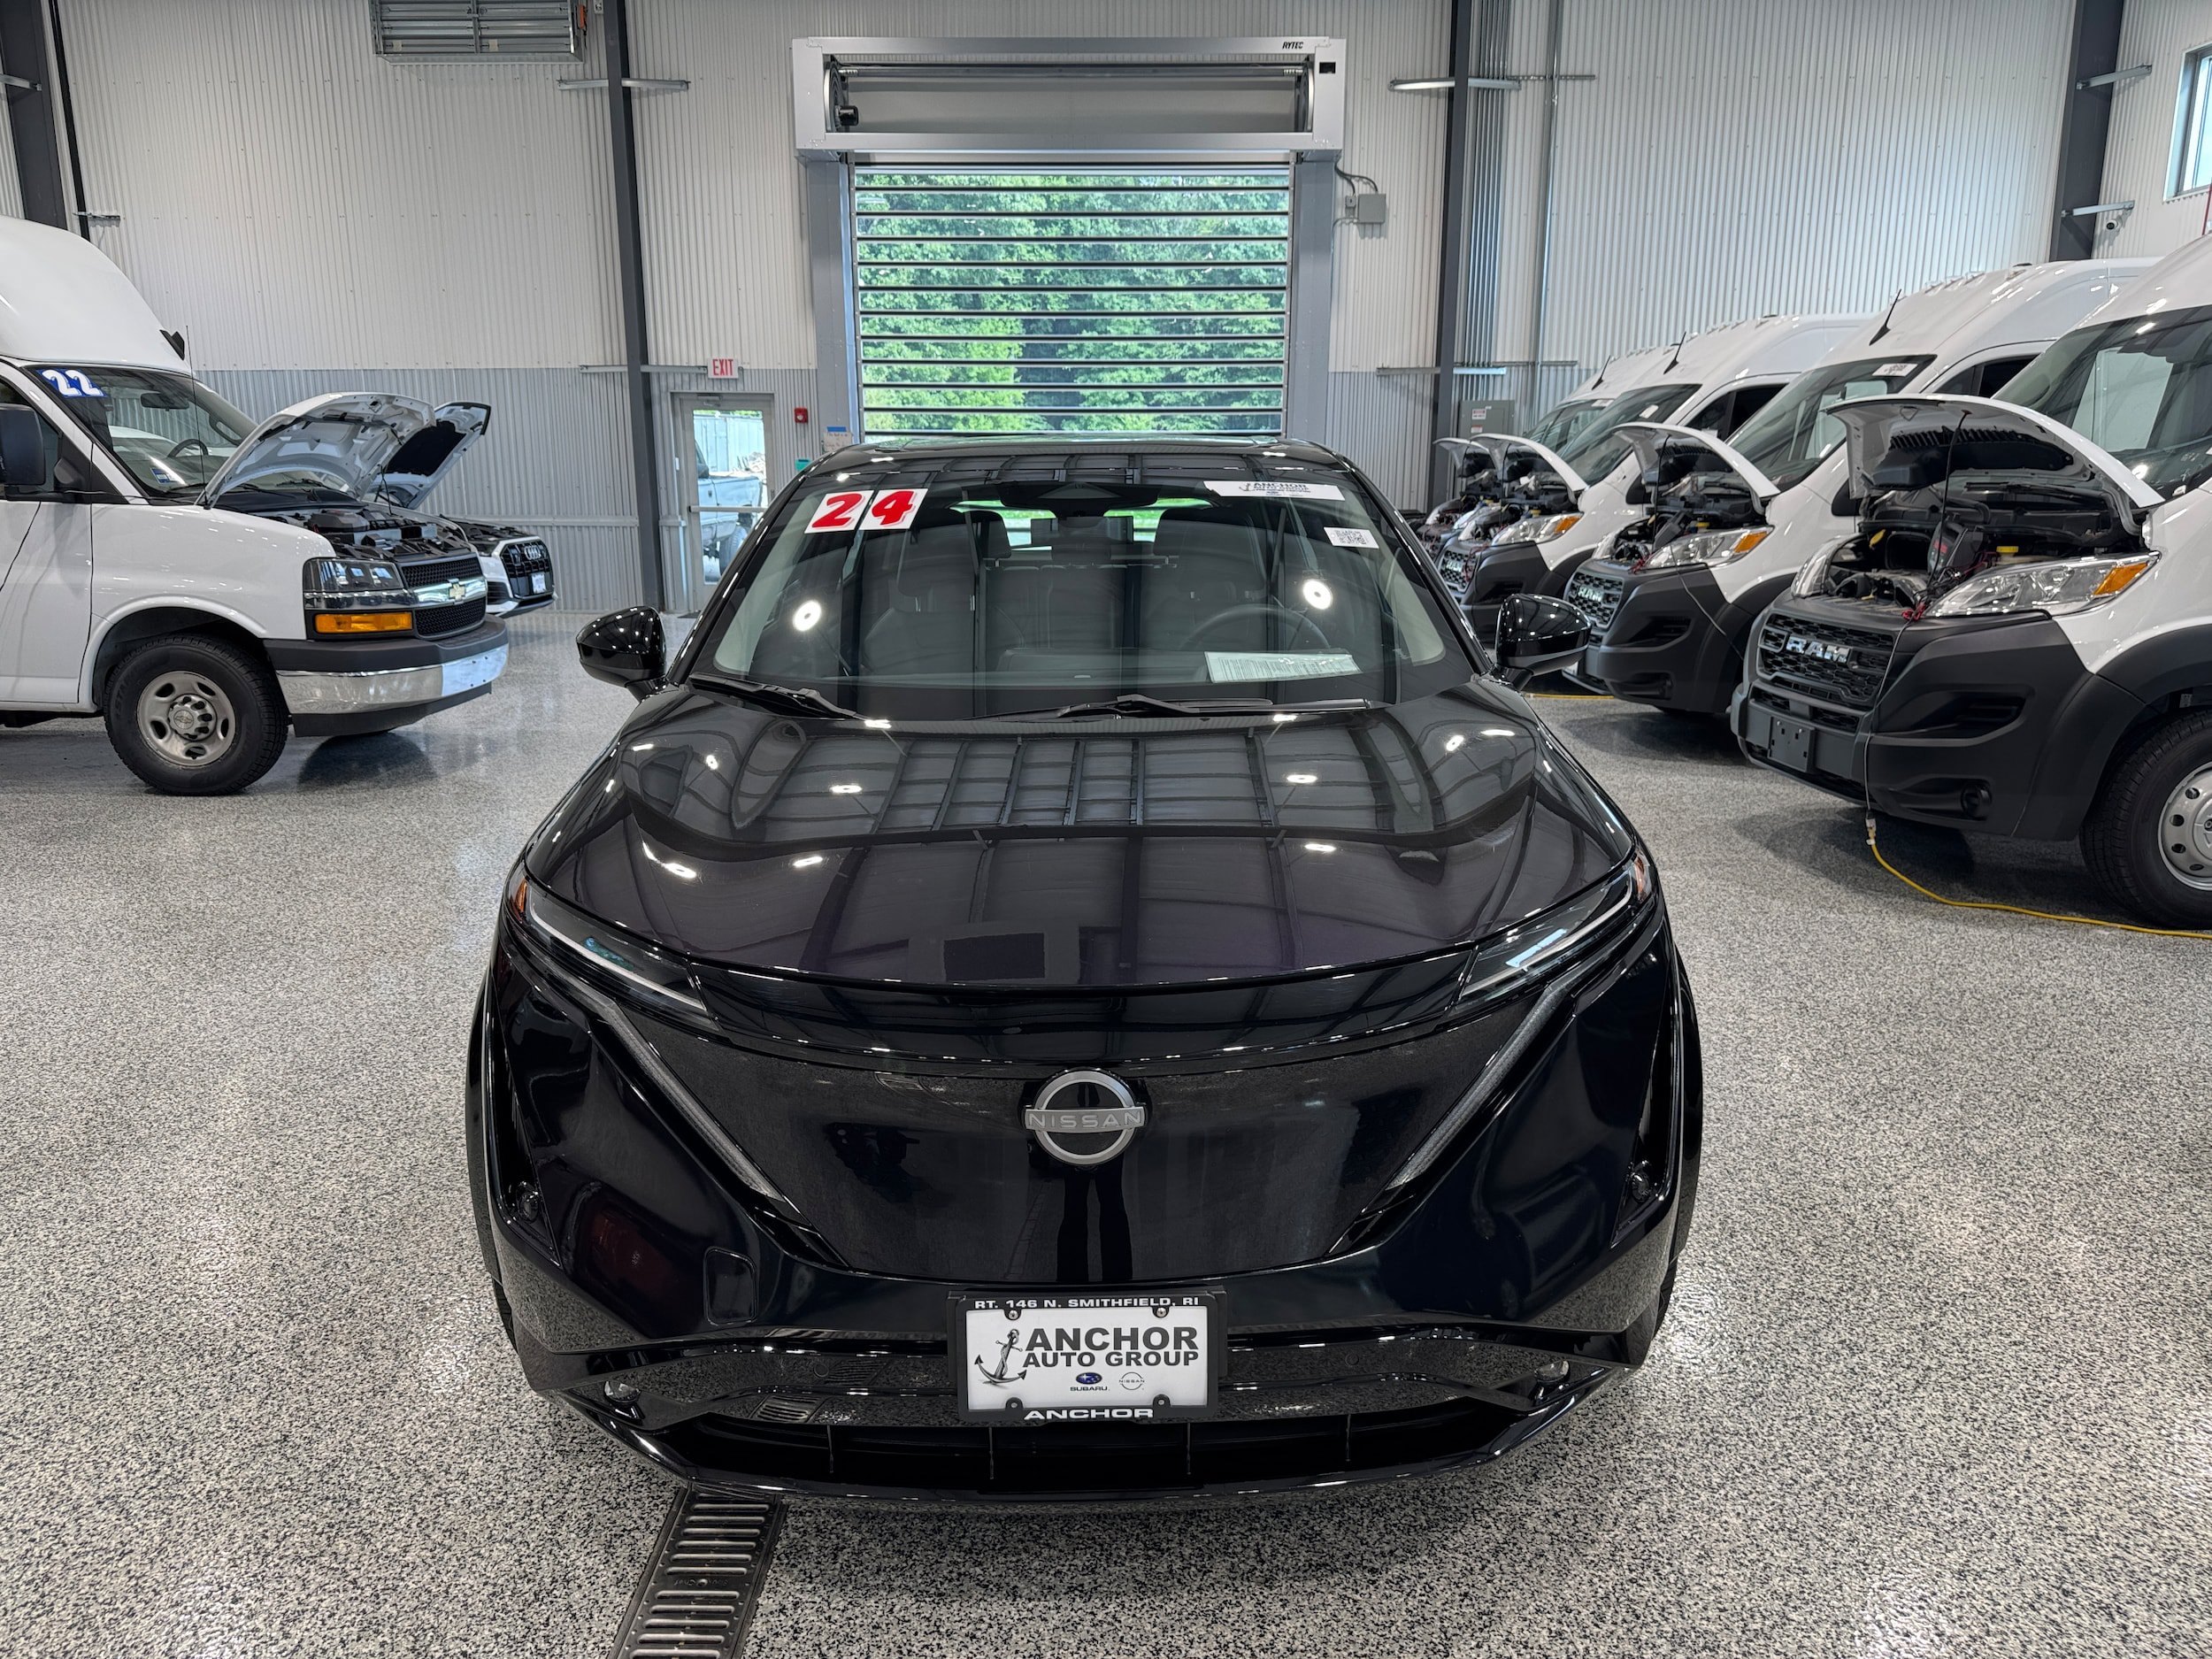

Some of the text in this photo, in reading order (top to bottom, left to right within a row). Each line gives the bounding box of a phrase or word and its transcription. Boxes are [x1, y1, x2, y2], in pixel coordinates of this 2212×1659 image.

[712, 358, 733, 376] EXIT
[42, 369, 104, 396] 22
[811, 490, 915, 528] 24
[1786, 636, 1850, 664] RAM
[1028, 1111, 1141, 1129] NISSAN
[974, 1300, 999, 1310] RT.
[1005, 1298, 1038, 1309] 146
[1043, 1298, 1062, 1309] N.
[1182, 1296, 1200, 1306] RI
[1025, 1326, 1199, 1351] ANCHOR
[1022, 1350, 1199, 1368] AUTO GROUP
[1023, 1408, 1154, 1421] ANCHOR
